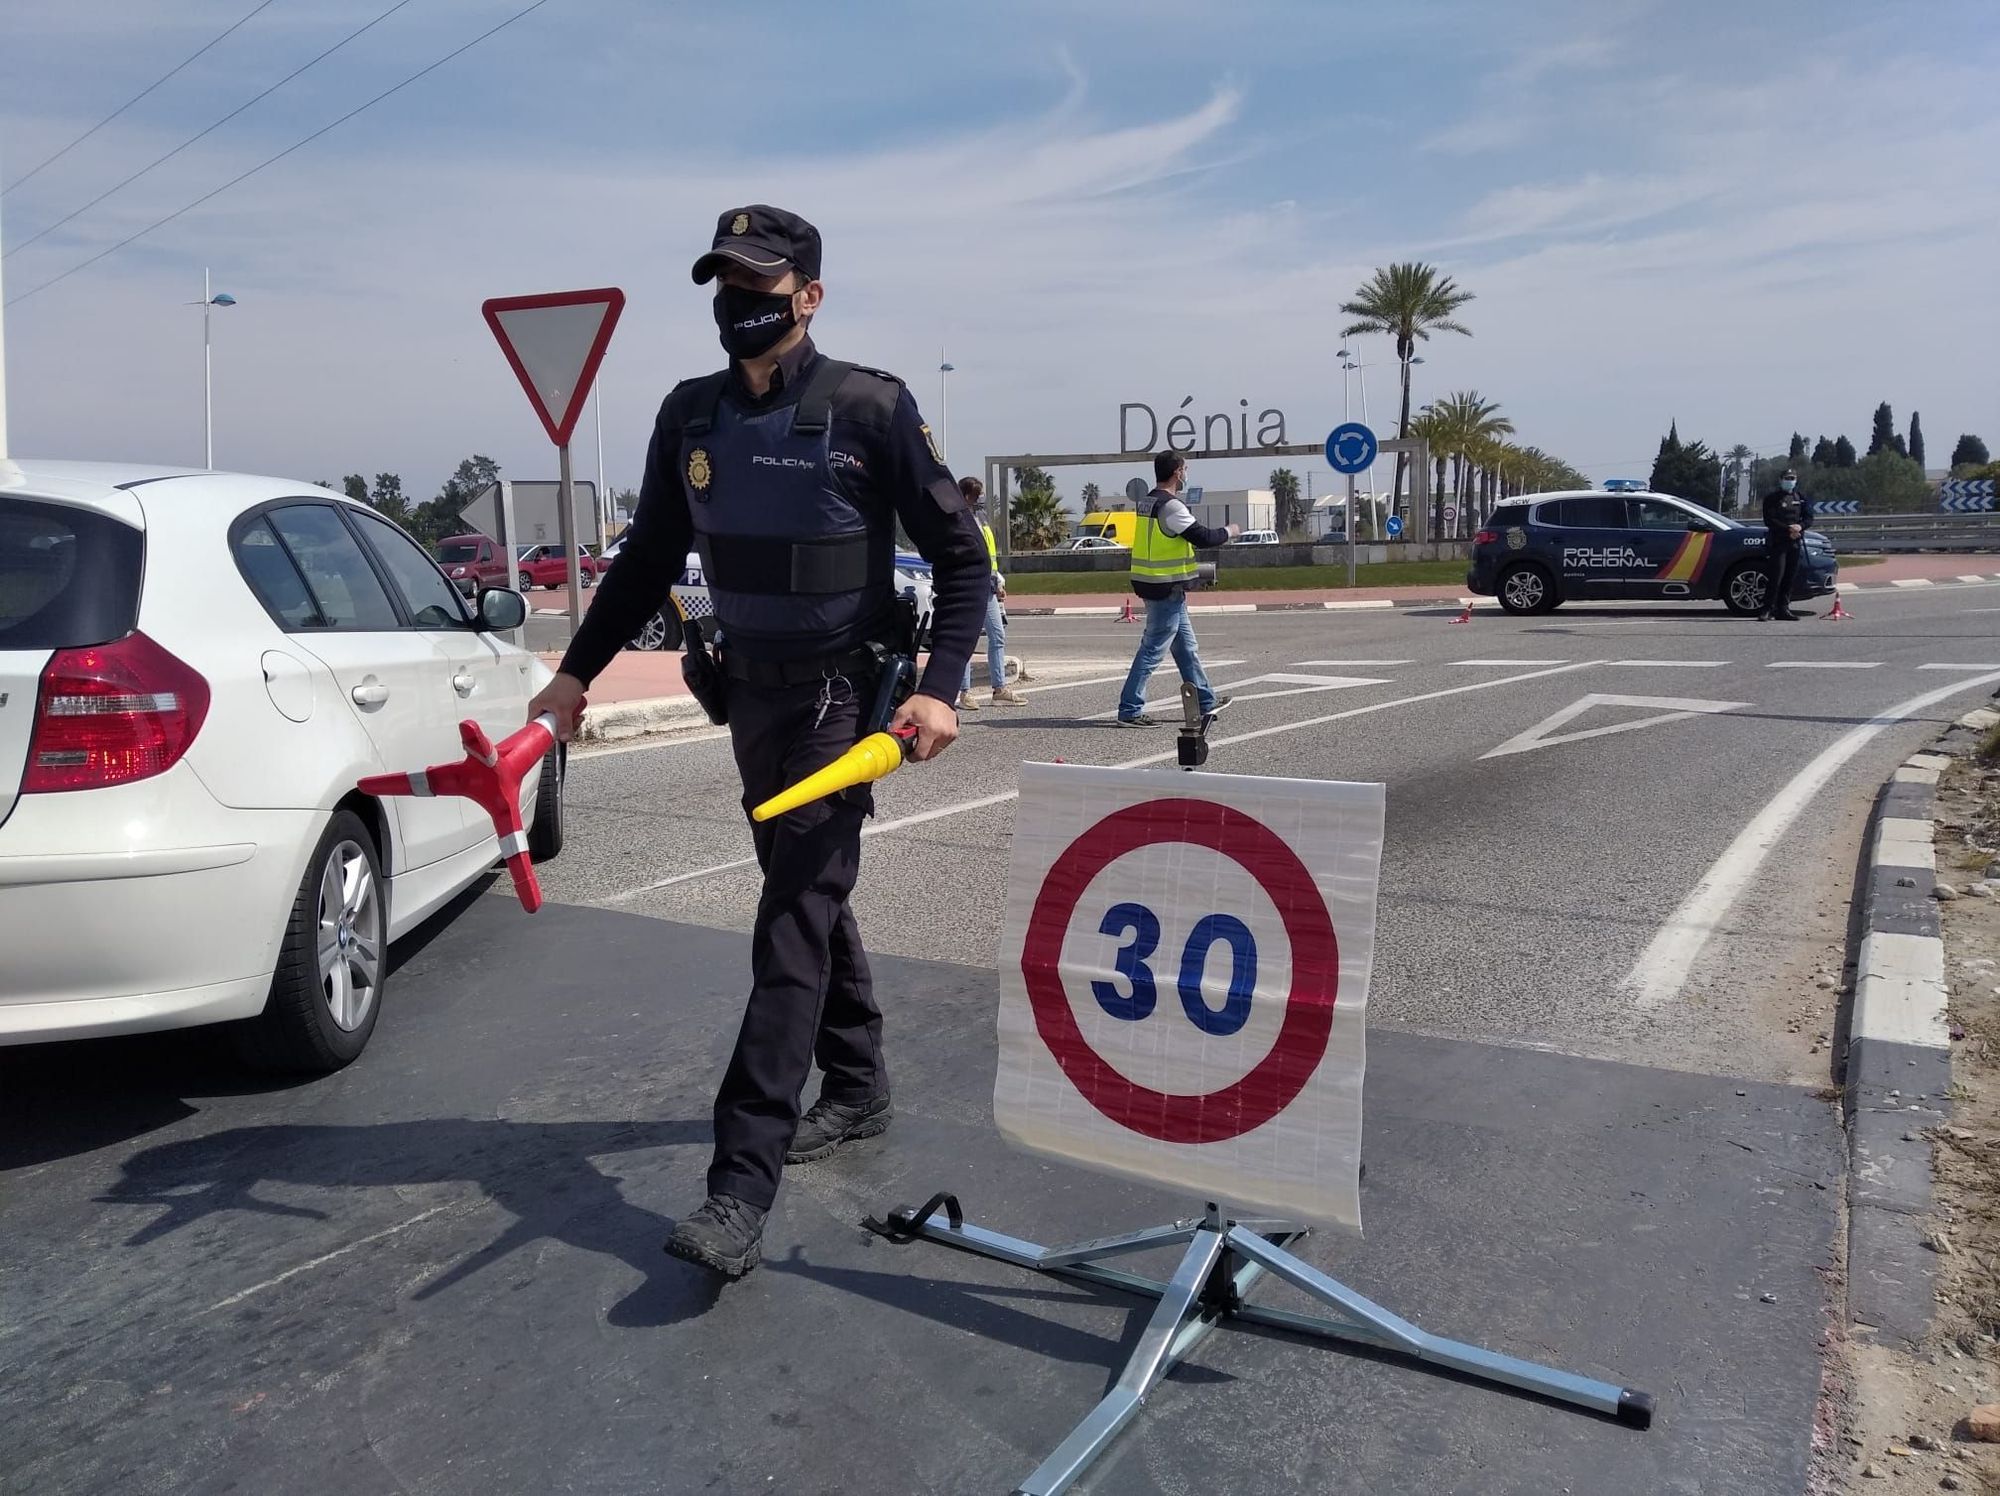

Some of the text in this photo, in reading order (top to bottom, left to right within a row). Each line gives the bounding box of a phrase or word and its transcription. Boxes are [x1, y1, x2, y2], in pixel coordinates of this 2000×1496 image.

[734, 313, 781, 331] POLICIA
[1120, 395, 1289, 453] Dénia
[752, 455, 805, 467] POLICIA
[829, 451, 856, 465] ICIA
[1563, 546, 1635, 557] POLICÍA
[1563, 557, 1658, 567] NACIONAL
[1091, 902, 1257, 1036] 30
